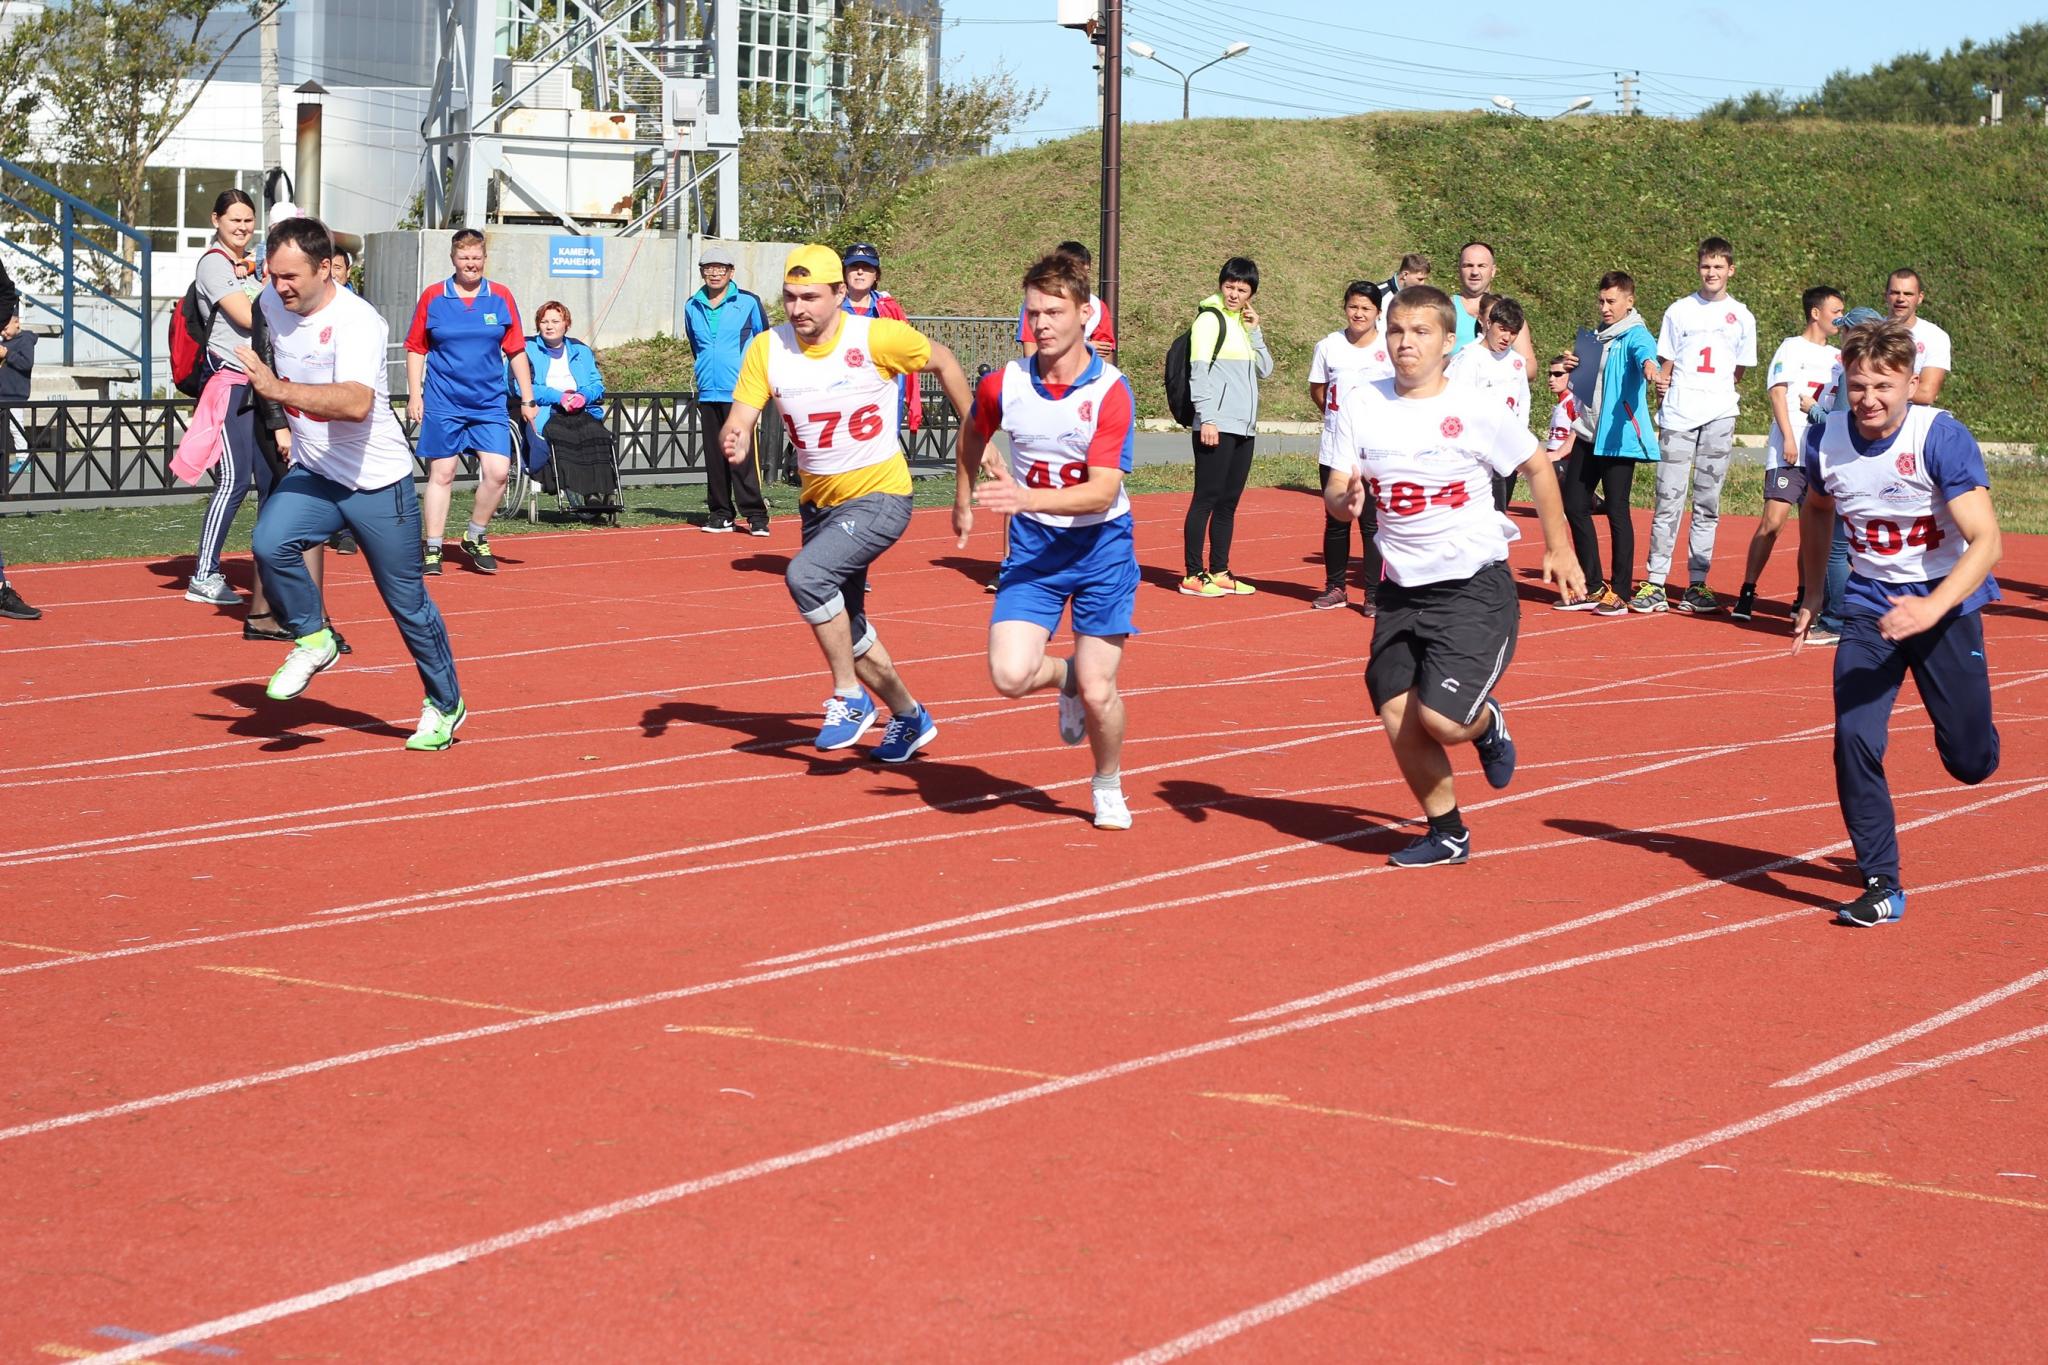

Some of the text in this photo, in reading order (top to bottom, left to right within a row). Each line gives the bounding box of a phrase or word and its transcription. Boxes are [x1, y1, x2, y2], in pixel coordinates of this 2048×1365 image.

[552, 257, 601, 267] ХРАНЕНИЯ
[558, 247, 596, 257] КАМЕРА
[1697, 346, 1716, 374] 1
[782, 403, 883, 450] 176
[1368, 477, 1471, 517] 184
[1840, 514, 1945, 557] 104
